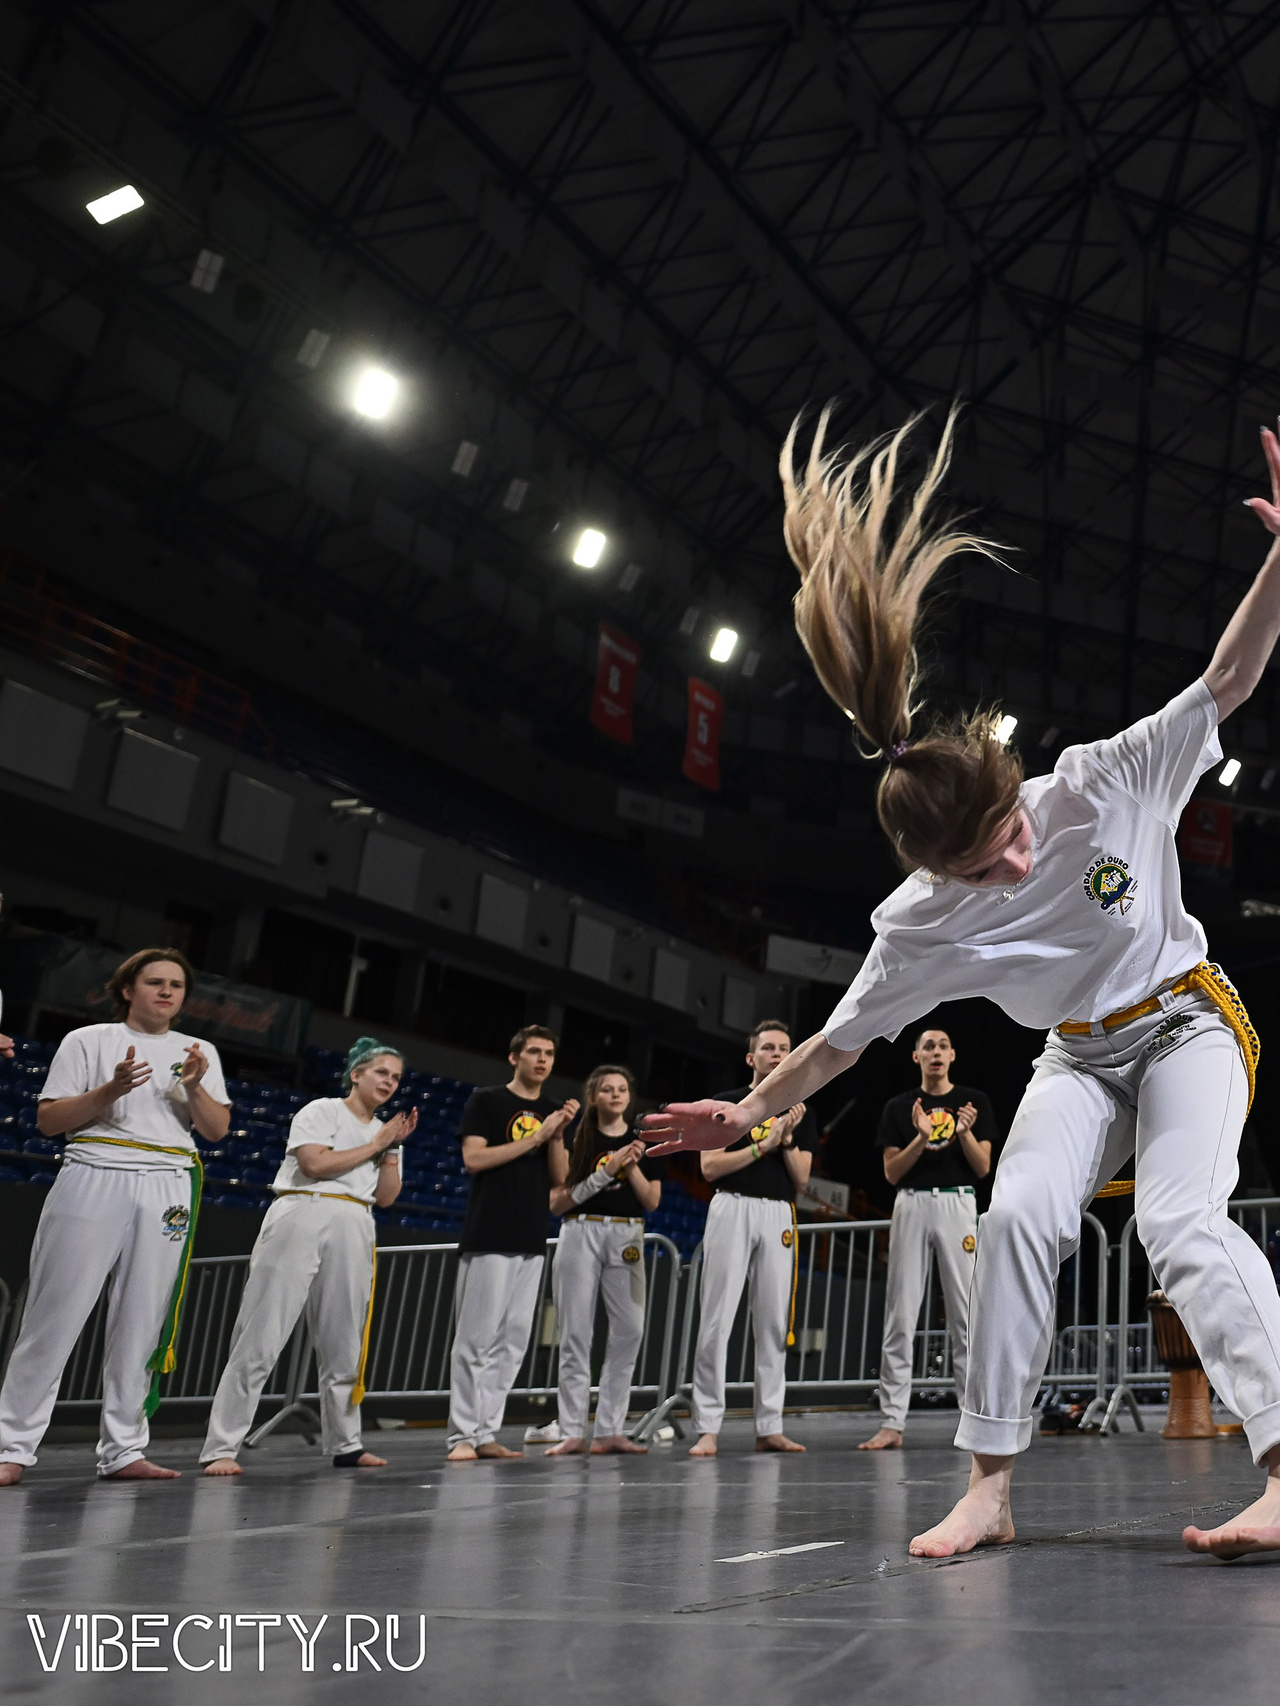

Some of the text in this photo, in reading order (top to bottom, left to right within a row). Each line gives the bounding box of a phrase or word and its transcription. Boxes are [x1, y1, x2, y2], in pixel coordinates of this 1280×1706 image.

[1083, 865, 1095, 901] CORDÃO
[1095, 857, 1106, 868] DE
[1107, 856, 1129, 870] OURO
